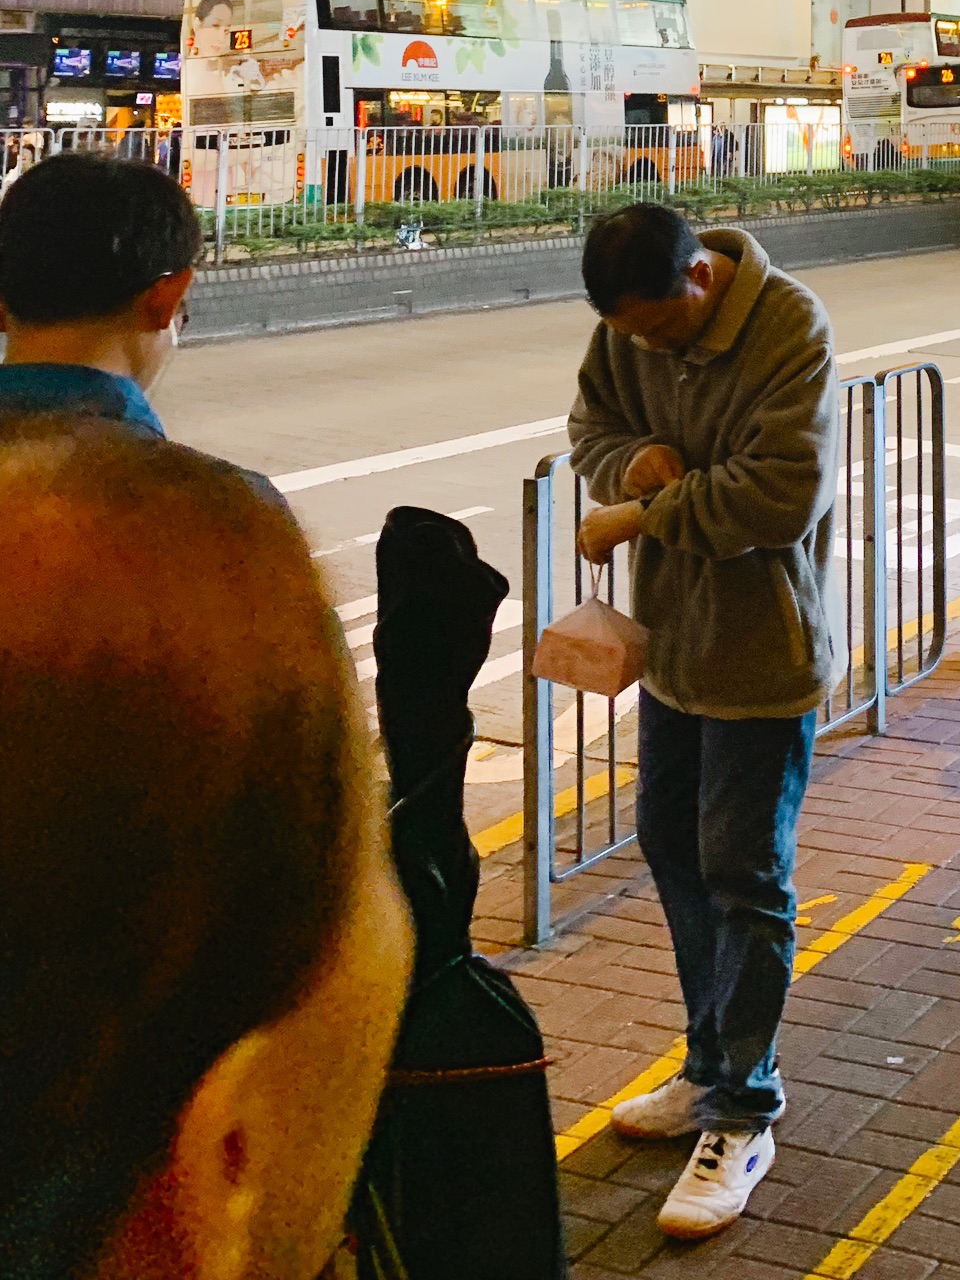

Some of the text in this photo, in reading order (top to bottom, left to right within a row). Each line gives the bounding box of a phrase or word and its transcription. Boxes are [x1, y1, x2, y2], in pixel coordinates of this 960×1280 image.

[234, 31, 250, 49] 23
[401, 73, 440, 82] LEE KUM KEE
[941, 69, 954, 83] 26
